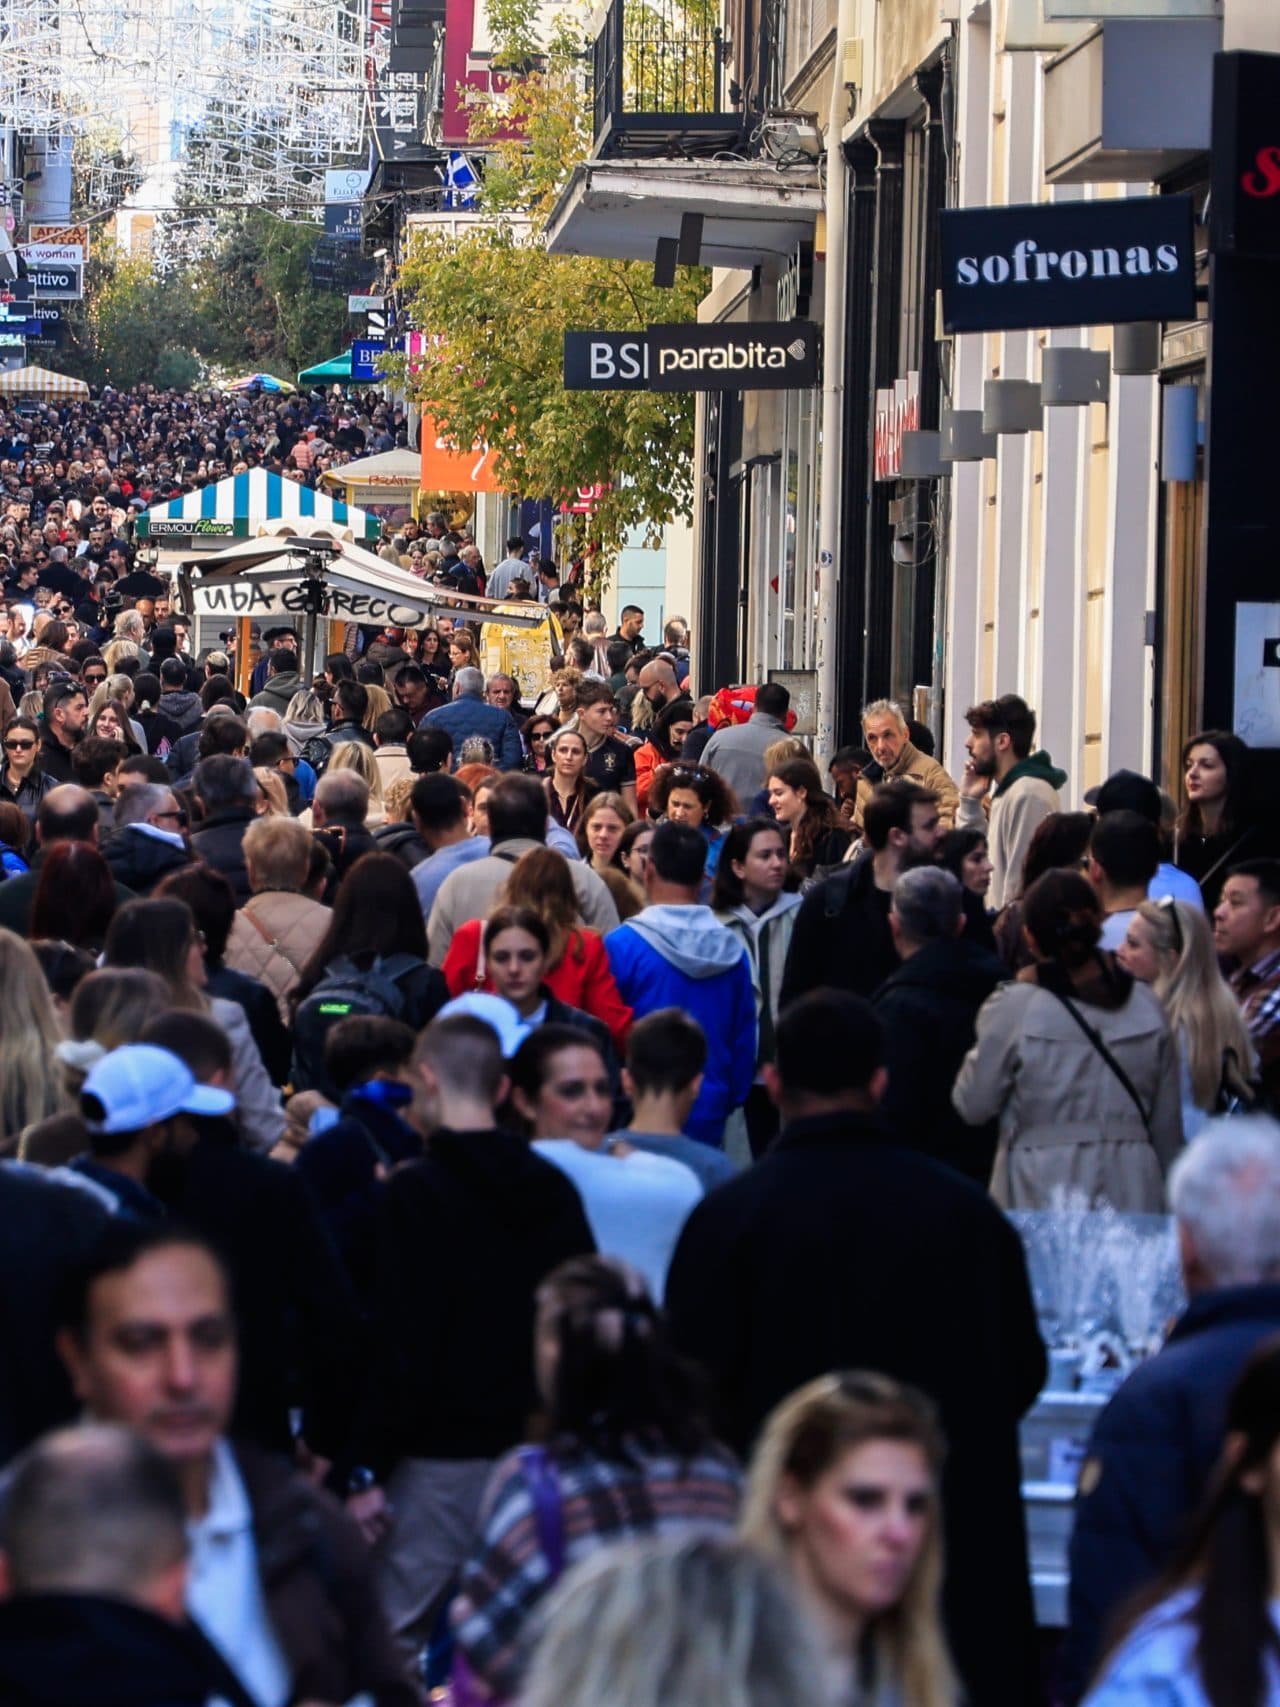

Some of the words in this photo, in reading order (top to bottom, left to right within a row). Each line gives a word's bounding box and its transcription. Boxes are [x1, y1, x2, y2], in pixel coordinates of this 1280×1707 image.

[35, 250, 76, 259] woman
[957, 239, 1179, 285] sofronas
[590, 342, 649, 379] BS
[659, 341, 786, 375] parabita
[150, 523, 194, 534] ERMOU
[194, 519, 234, 534] Flower
